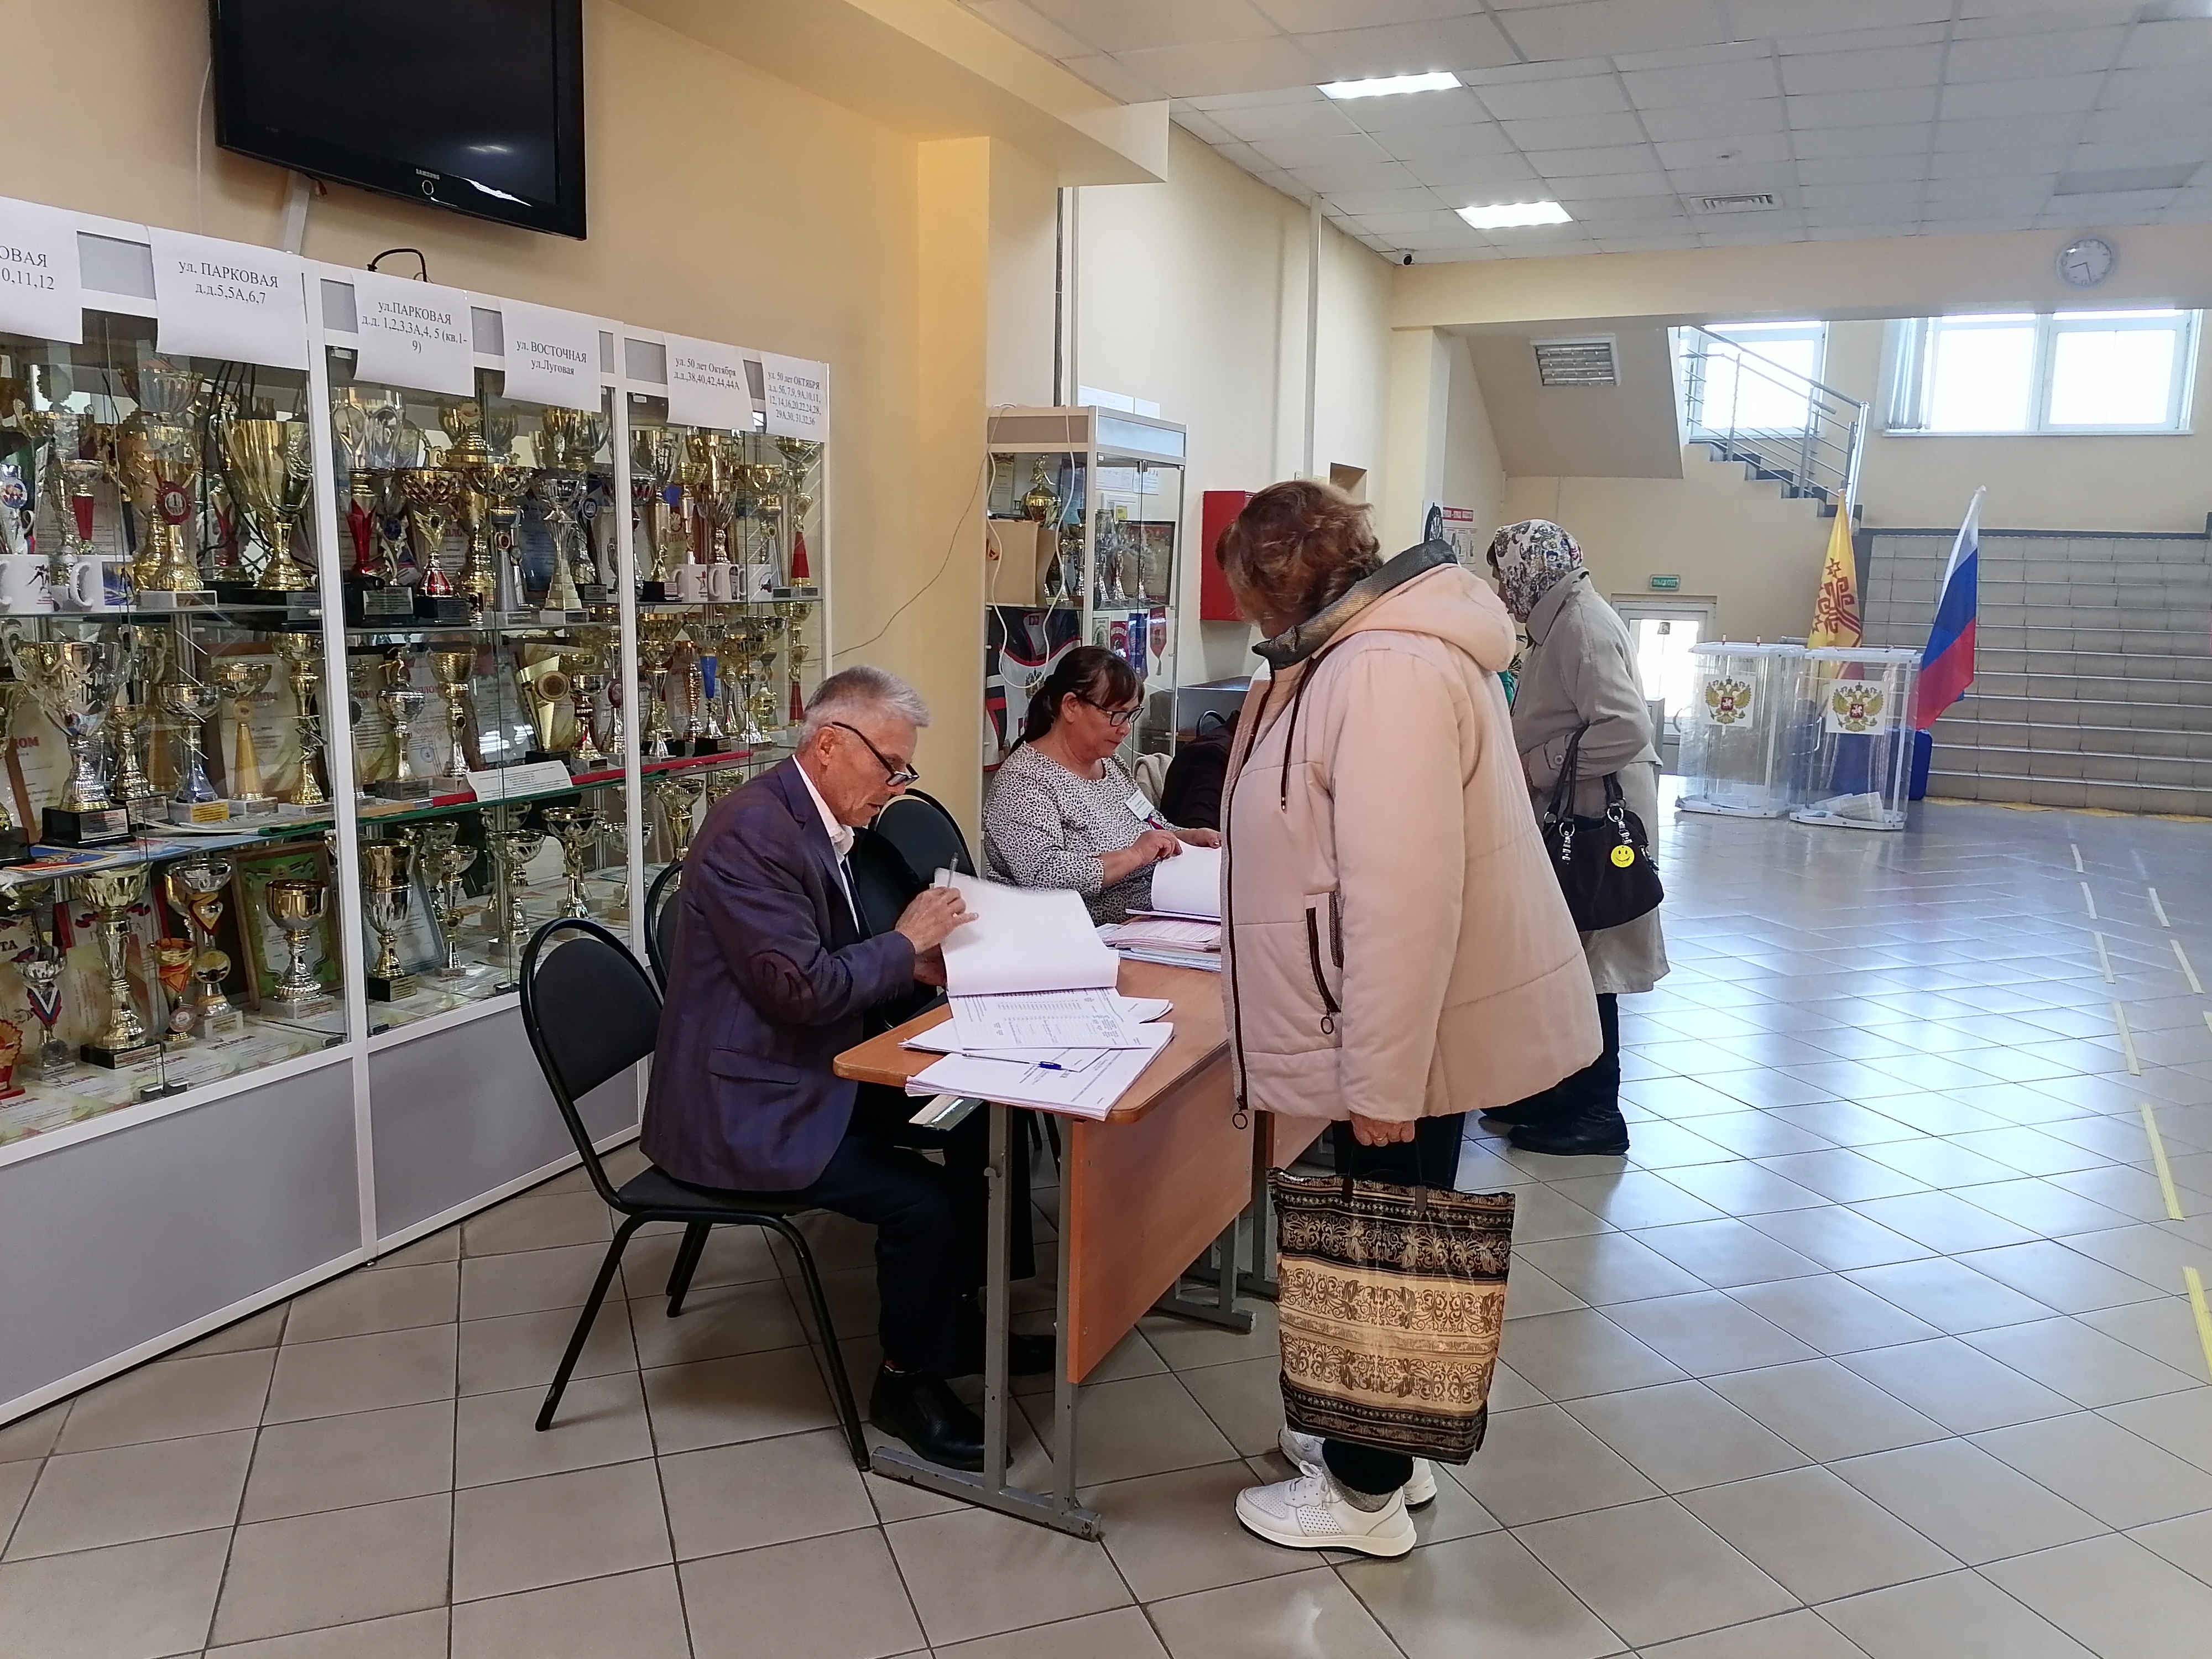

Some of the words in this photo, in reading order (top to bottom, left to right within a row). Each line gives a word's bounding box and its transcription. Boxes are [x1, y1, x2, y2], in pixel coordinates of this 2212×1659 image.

[179, 261, 197, 273] ул.
[201, 262, 279, 288] ПАРКОВАЯ
[195, 283, 266, 305] д.д.5,5А,6,7
[378, 302, 452, 325] ул.ПАРКОВАЯ
[362, 316, 380, 327] д.д.
[434, 328, 440, 339] 5
[412, 340, 421, 354] 9)
[517, 341, 529, 351] ул.
[531, 341, 587, 363] ВОСТОЧНАЯ
[531, 359, 575, 375] ул.Луговая
[675, 358, 686, 367] ул.
[687, 358, 695, 368] 50
[696, 362, 707, 372] лет
[708, 363, 737, 378] Октября
[777, 372, 784, 382] 50
[794, 376, 820, 390] ОКТЯБРЯ
